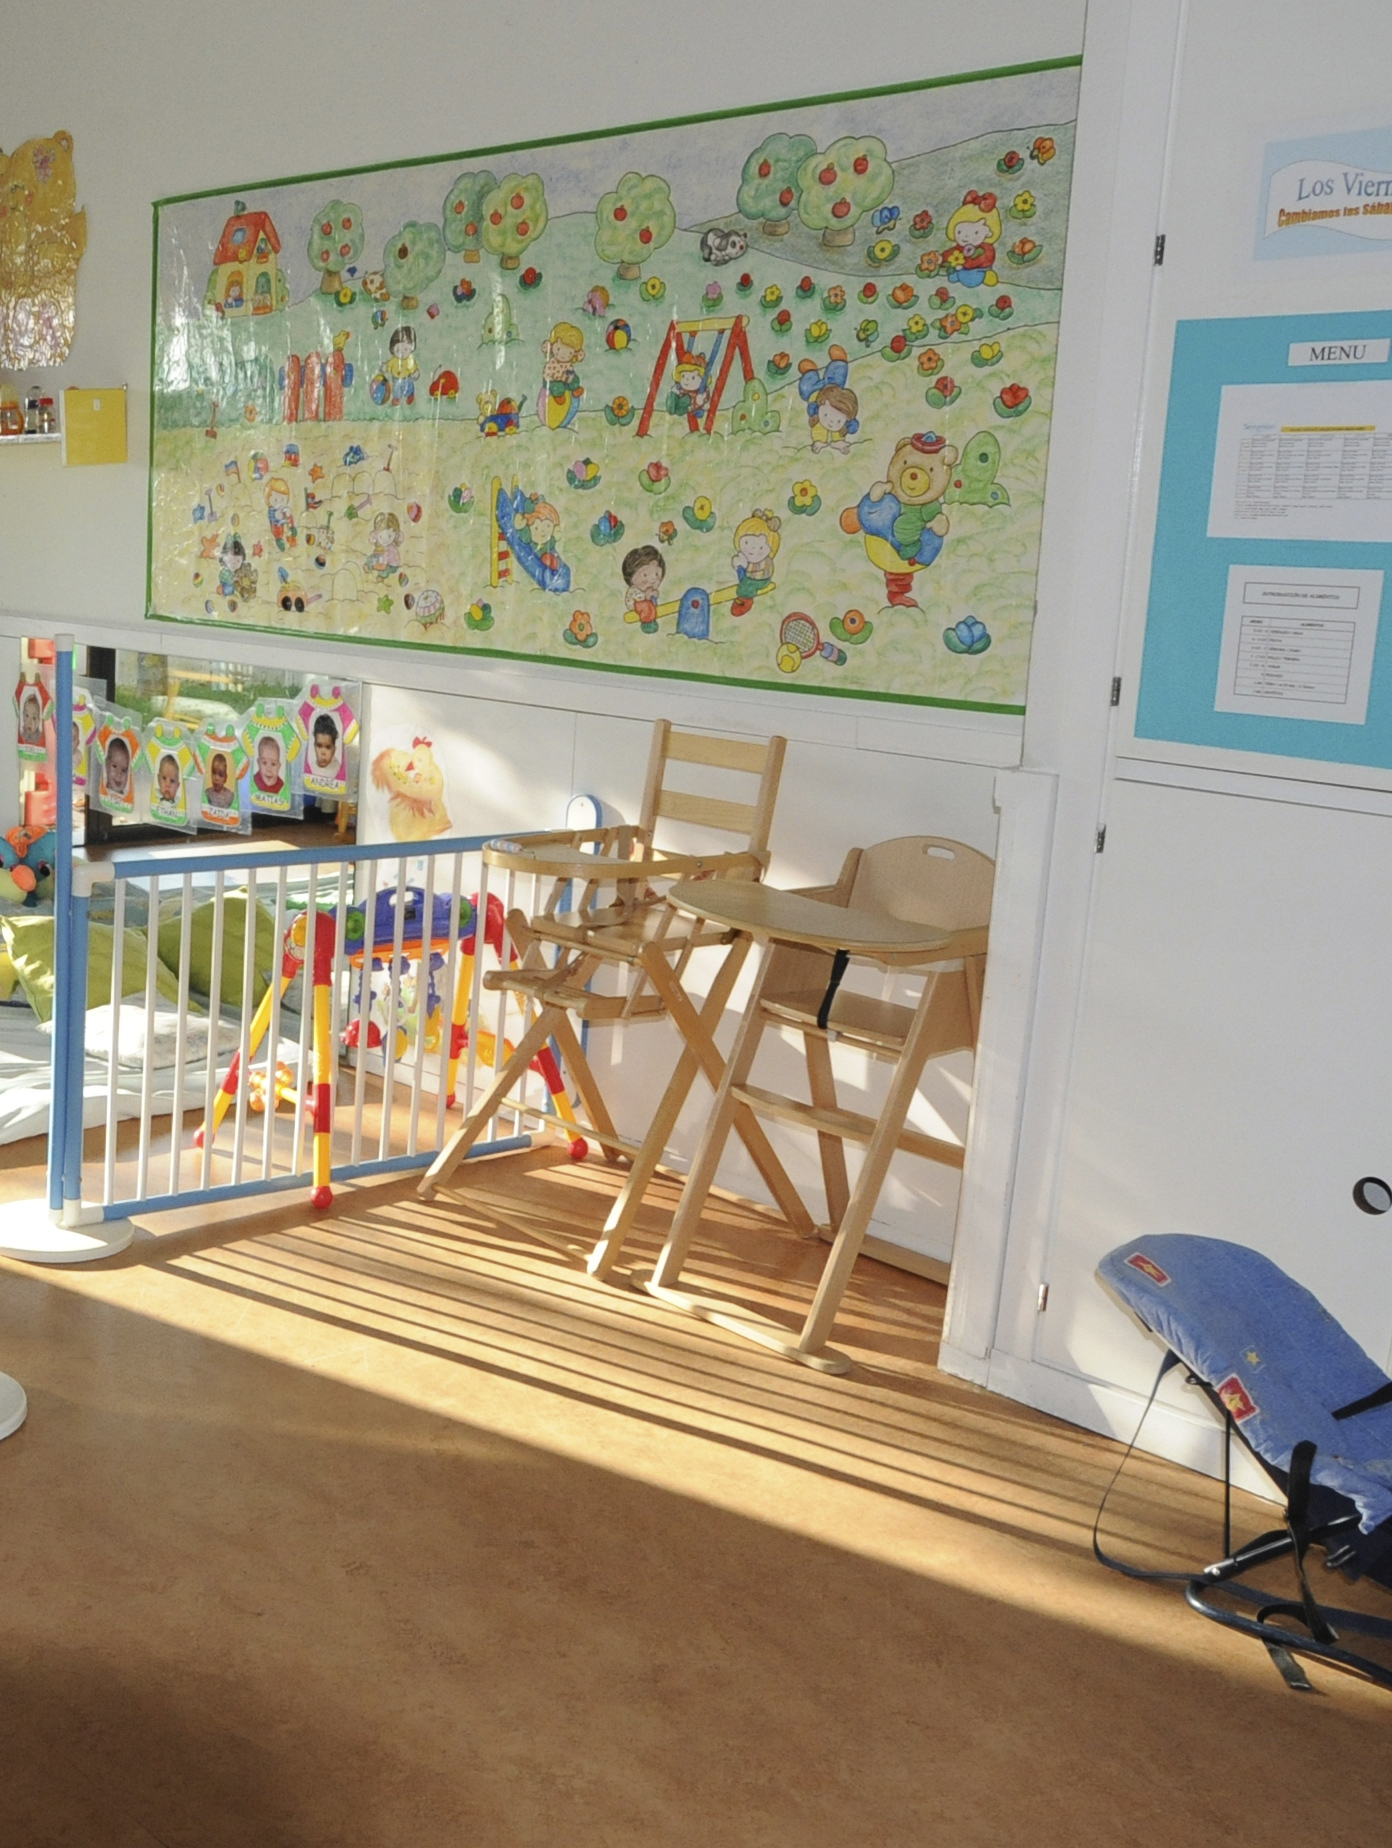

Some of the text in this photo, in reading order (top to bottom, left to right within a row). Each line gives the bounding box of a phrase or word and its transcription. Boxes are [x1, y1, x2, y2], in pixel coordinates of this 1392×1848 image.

[1296, 176, 1335, 202] Los
[1277, 207, 1341, 228] Cambiamos
[1362, 201, 1392, 215] Sába
[1309, 344, 1367, 362] MENU
